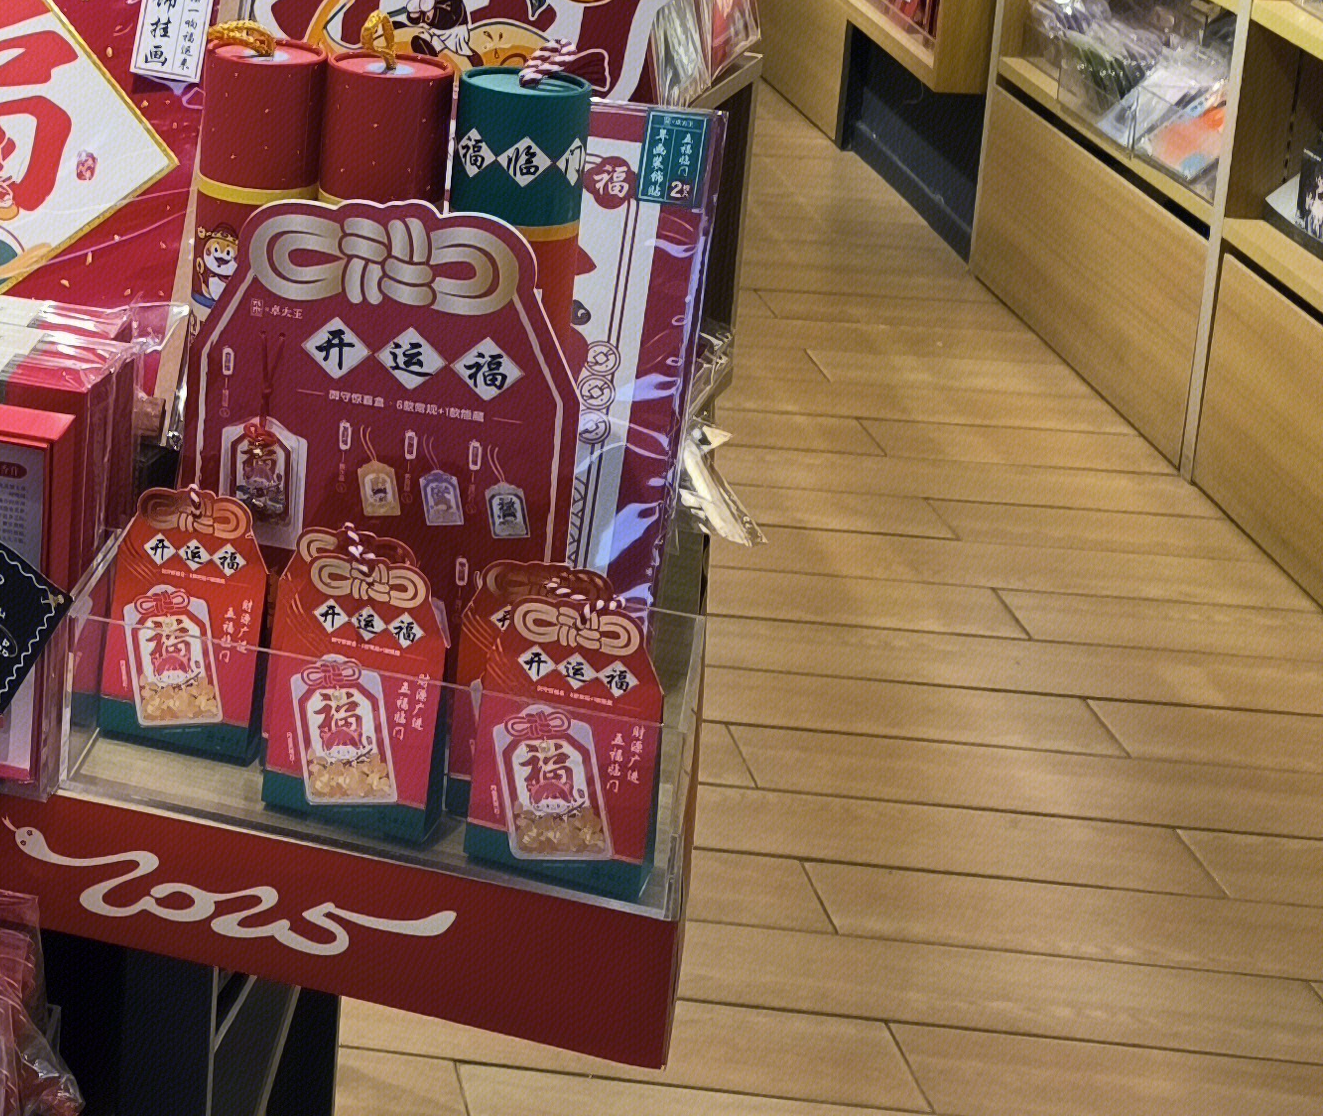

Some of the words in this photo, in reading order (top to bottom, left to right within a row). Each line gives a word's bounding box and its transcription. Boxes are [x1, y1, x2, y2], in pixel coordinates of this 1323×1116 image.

[593, 164, 629, 198] 福
[316, 329, 508, 390] 开运福
[149, 539, 241, 571] 开运福
[320, 605, 418, 645] 开运福
[524, 651, 631, 692] 开运福
